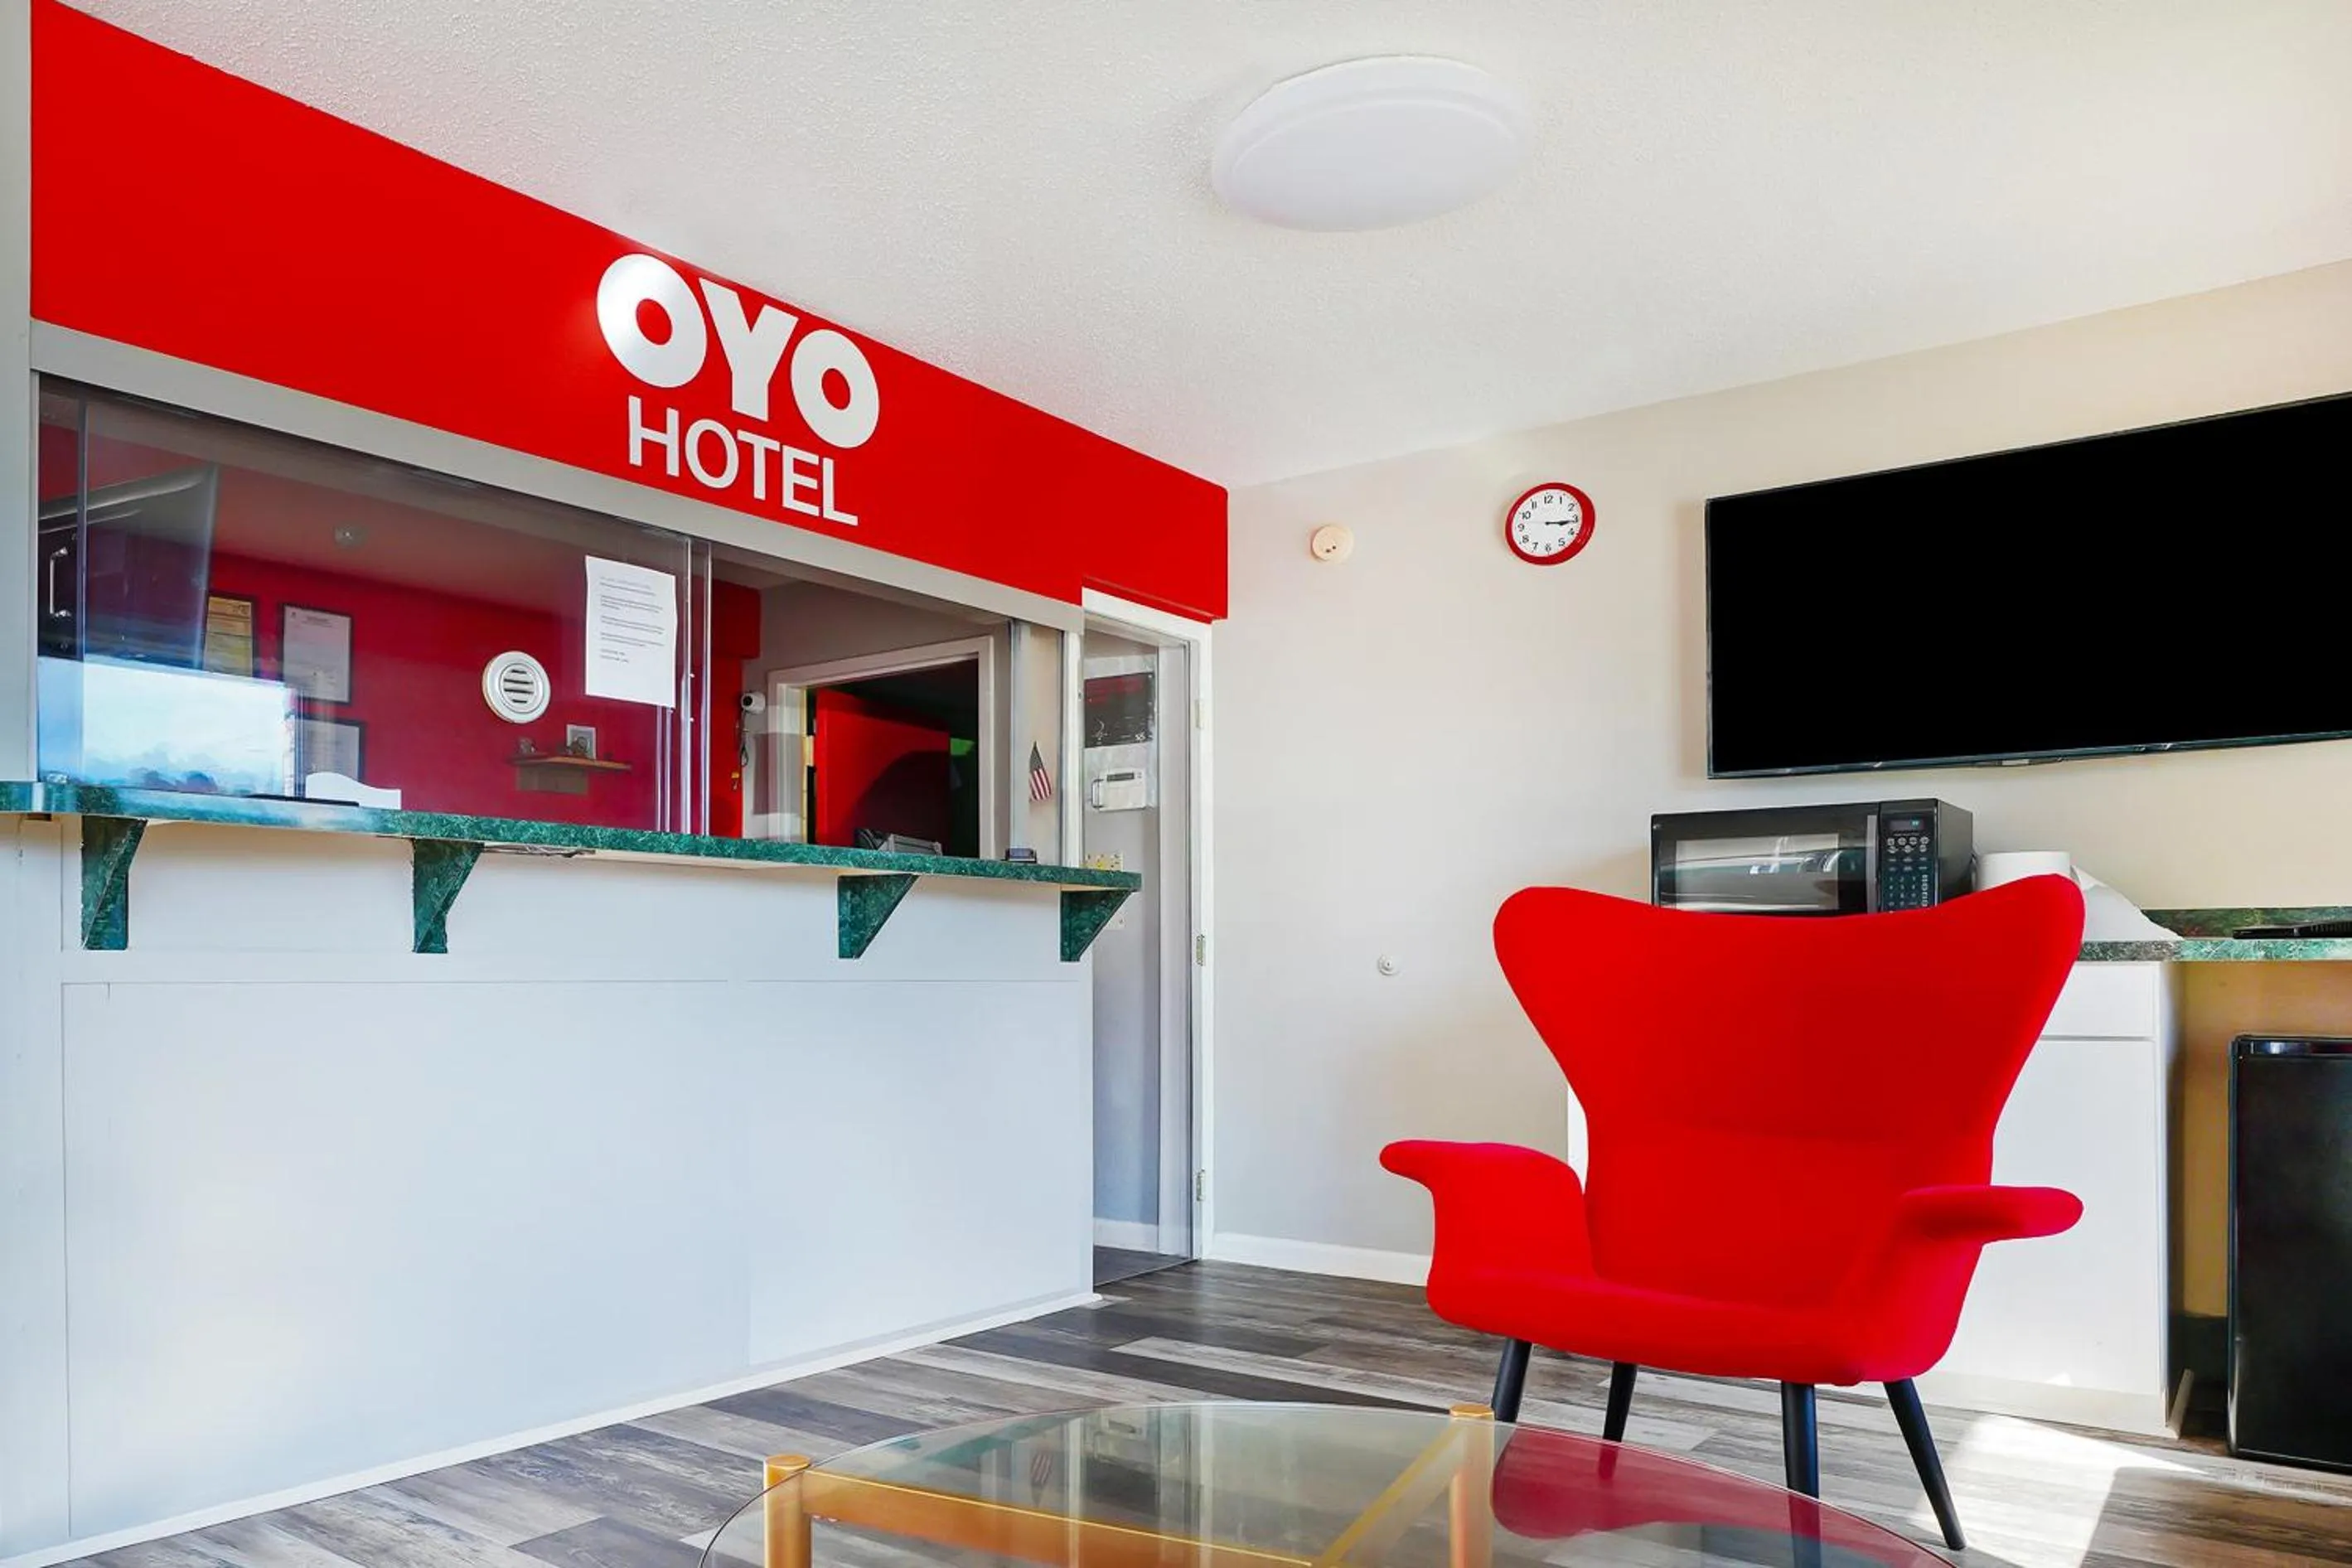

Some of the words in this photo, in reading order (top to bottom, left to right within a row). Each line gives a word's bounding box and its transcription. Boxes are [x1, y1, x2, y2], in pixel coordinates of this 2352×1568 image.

[597, 253, 880, 449] OYO
[627, 394, 859, 526] HOTEL
[1544, 495, 1553, 504] 12
[1559, 496, 1563, 504] 1
[1532, 501, 1537, 510] 11
[1568, 503, 1575, 511] 2
[1522, 511, 1531, 520] 10
[1572, 515, 1578, 523] 3
[1522, 535, 1529, 544] 8
[1558, 538, 1565, 546] 5
[1532, 542, 1538, 550] 7
[1545, 544, 1551, 552] 6
